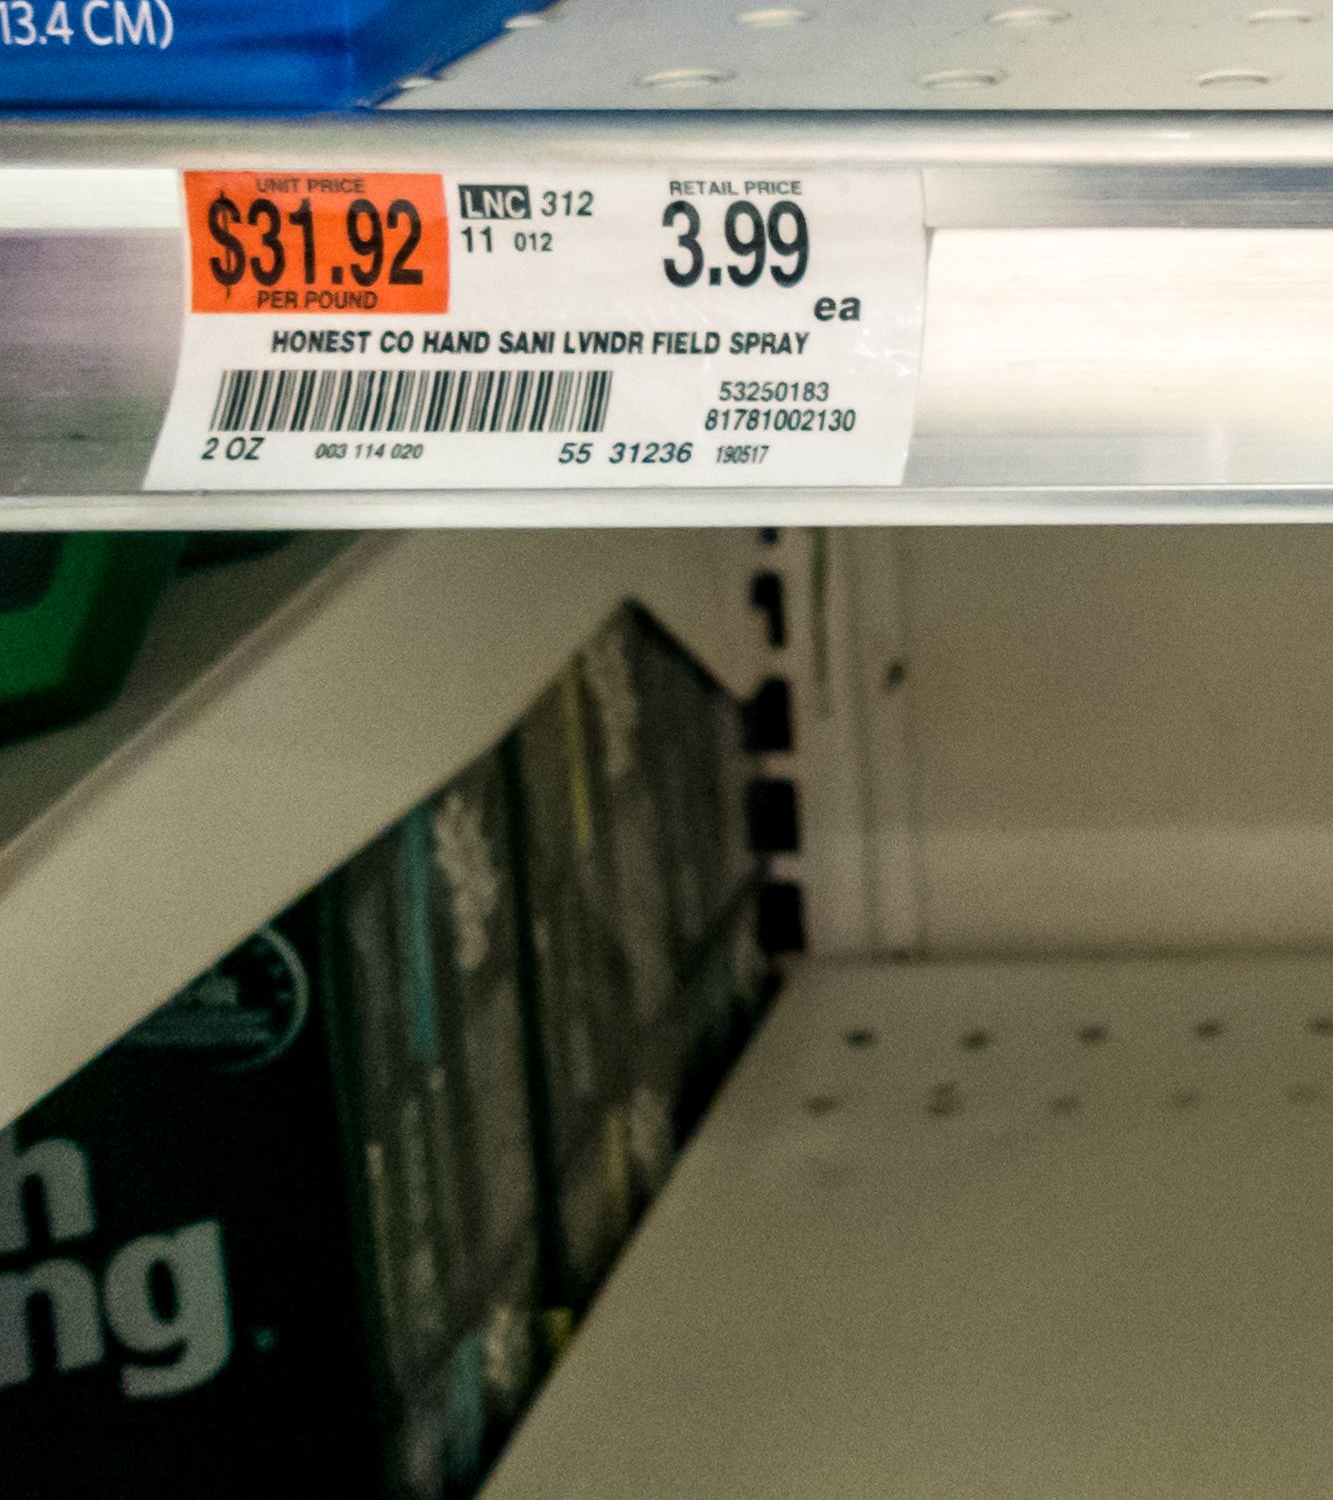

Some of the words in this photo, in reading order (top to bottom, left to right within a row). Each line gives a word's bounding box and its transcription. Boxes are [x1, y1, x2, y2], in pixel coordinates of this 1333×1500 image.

[255, 178, 299, 193] UNIT
[307, 178, 366, 194] PRICE
[669, 181, 739, 196] RETAIL
[744, 181, 803, 196] PRICE
[459, 185, 531, 219] LNC
[541, 191, 594, 218] 312
[207, 189, 424, 300] $31.92
[461, 226, 494, 253] 11
[513, 231, 553, 252] 012
[661, 199, 810, 288] 3.99
[257, 290, 298, 309] PER
[304, 290, 378, 310] POUND
[813, 296, 862, 322] ea
[271, 330, 373, 354] HONEST
[380, 330, 414, 354] CO
[422, 330, 491, 354] HAND
[499, 331, 556, 355] SANI
[563, 331, 644, 355] LVNDR
[652, 331, 721, 355] FIELD
[729, 331, 810, 356] SPRAY
[719, 381, 830, 403] 53250183
[704, 408, 857, 432] 81781002130
[201, 437, 220, 460] 2
[226, 437, 266, 461] OZ
[354, 443, 387, 460] 114
[558, 442, 593, 465] 55
[608, 442, 694, 465] 31236
